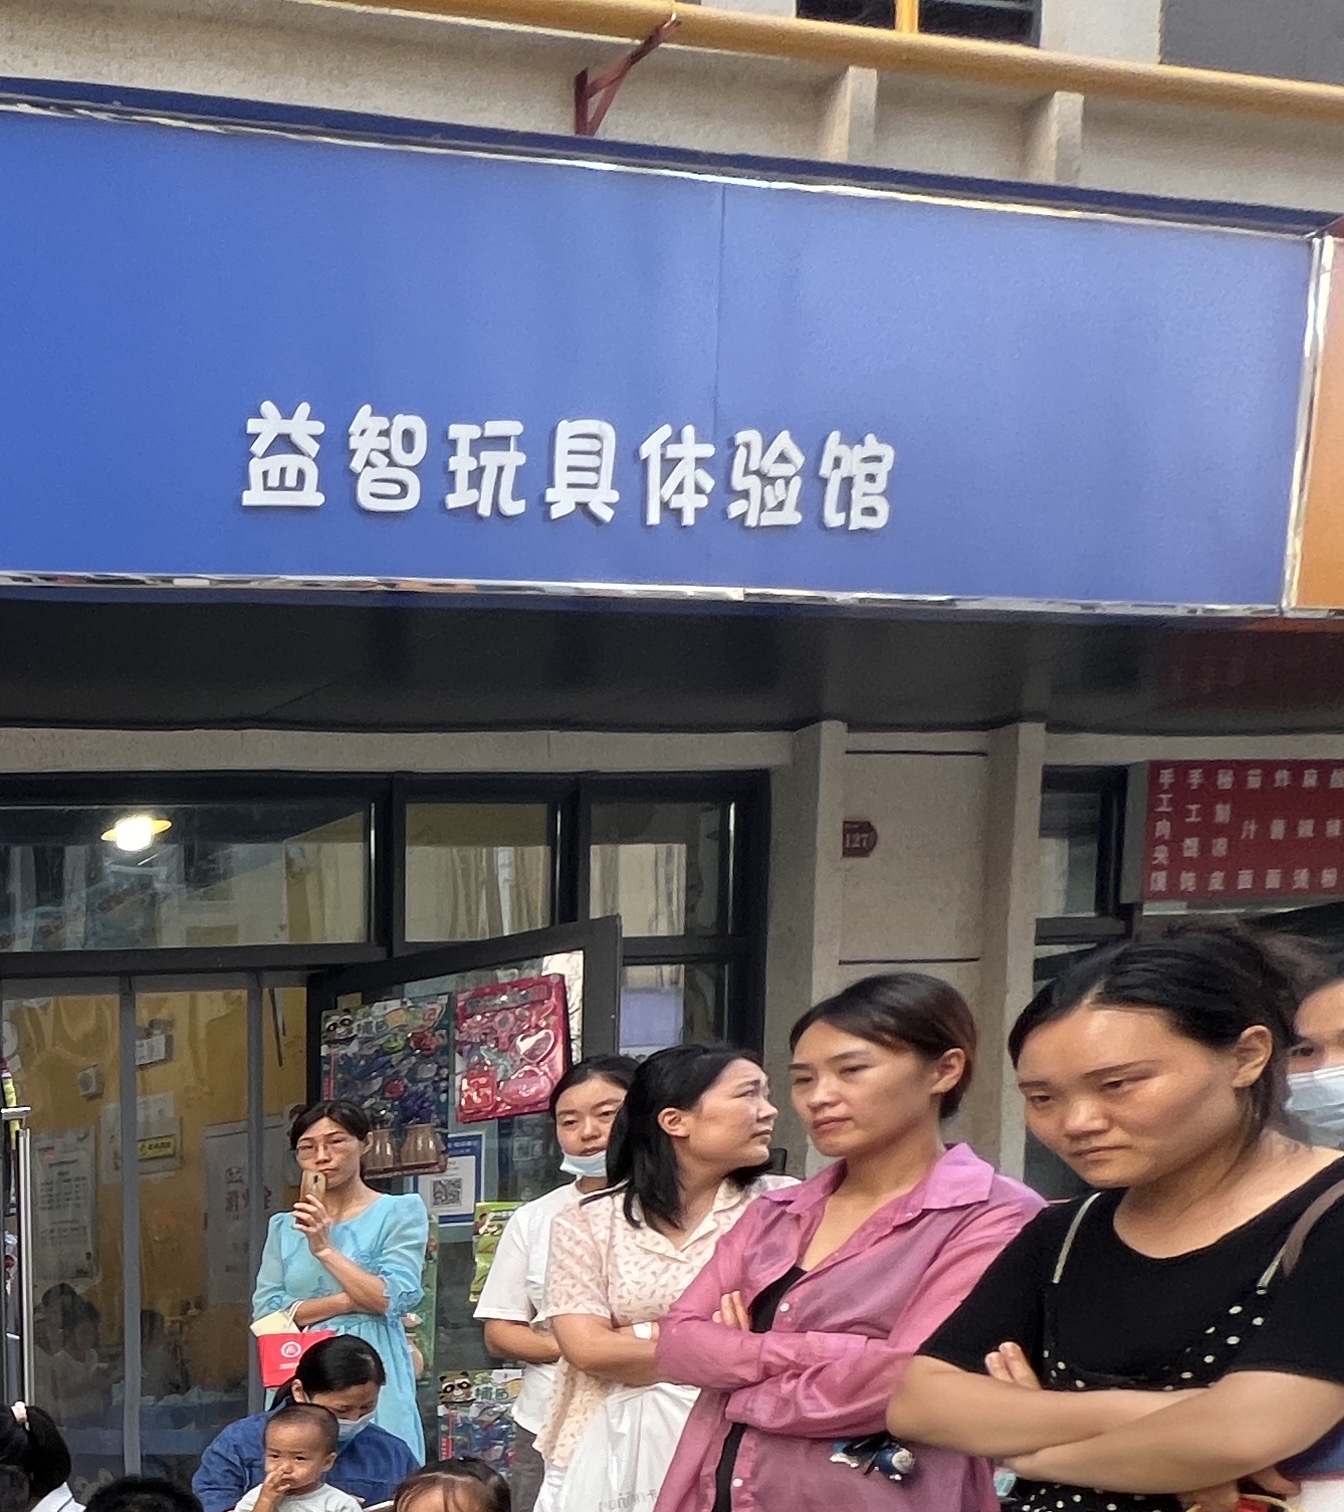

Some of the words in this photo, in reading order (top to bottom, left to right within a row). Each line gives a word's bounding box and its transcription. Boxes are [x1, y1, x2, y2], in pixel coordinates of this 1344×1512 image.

[242, 400, 895, 530] 益智玩具体验馆
